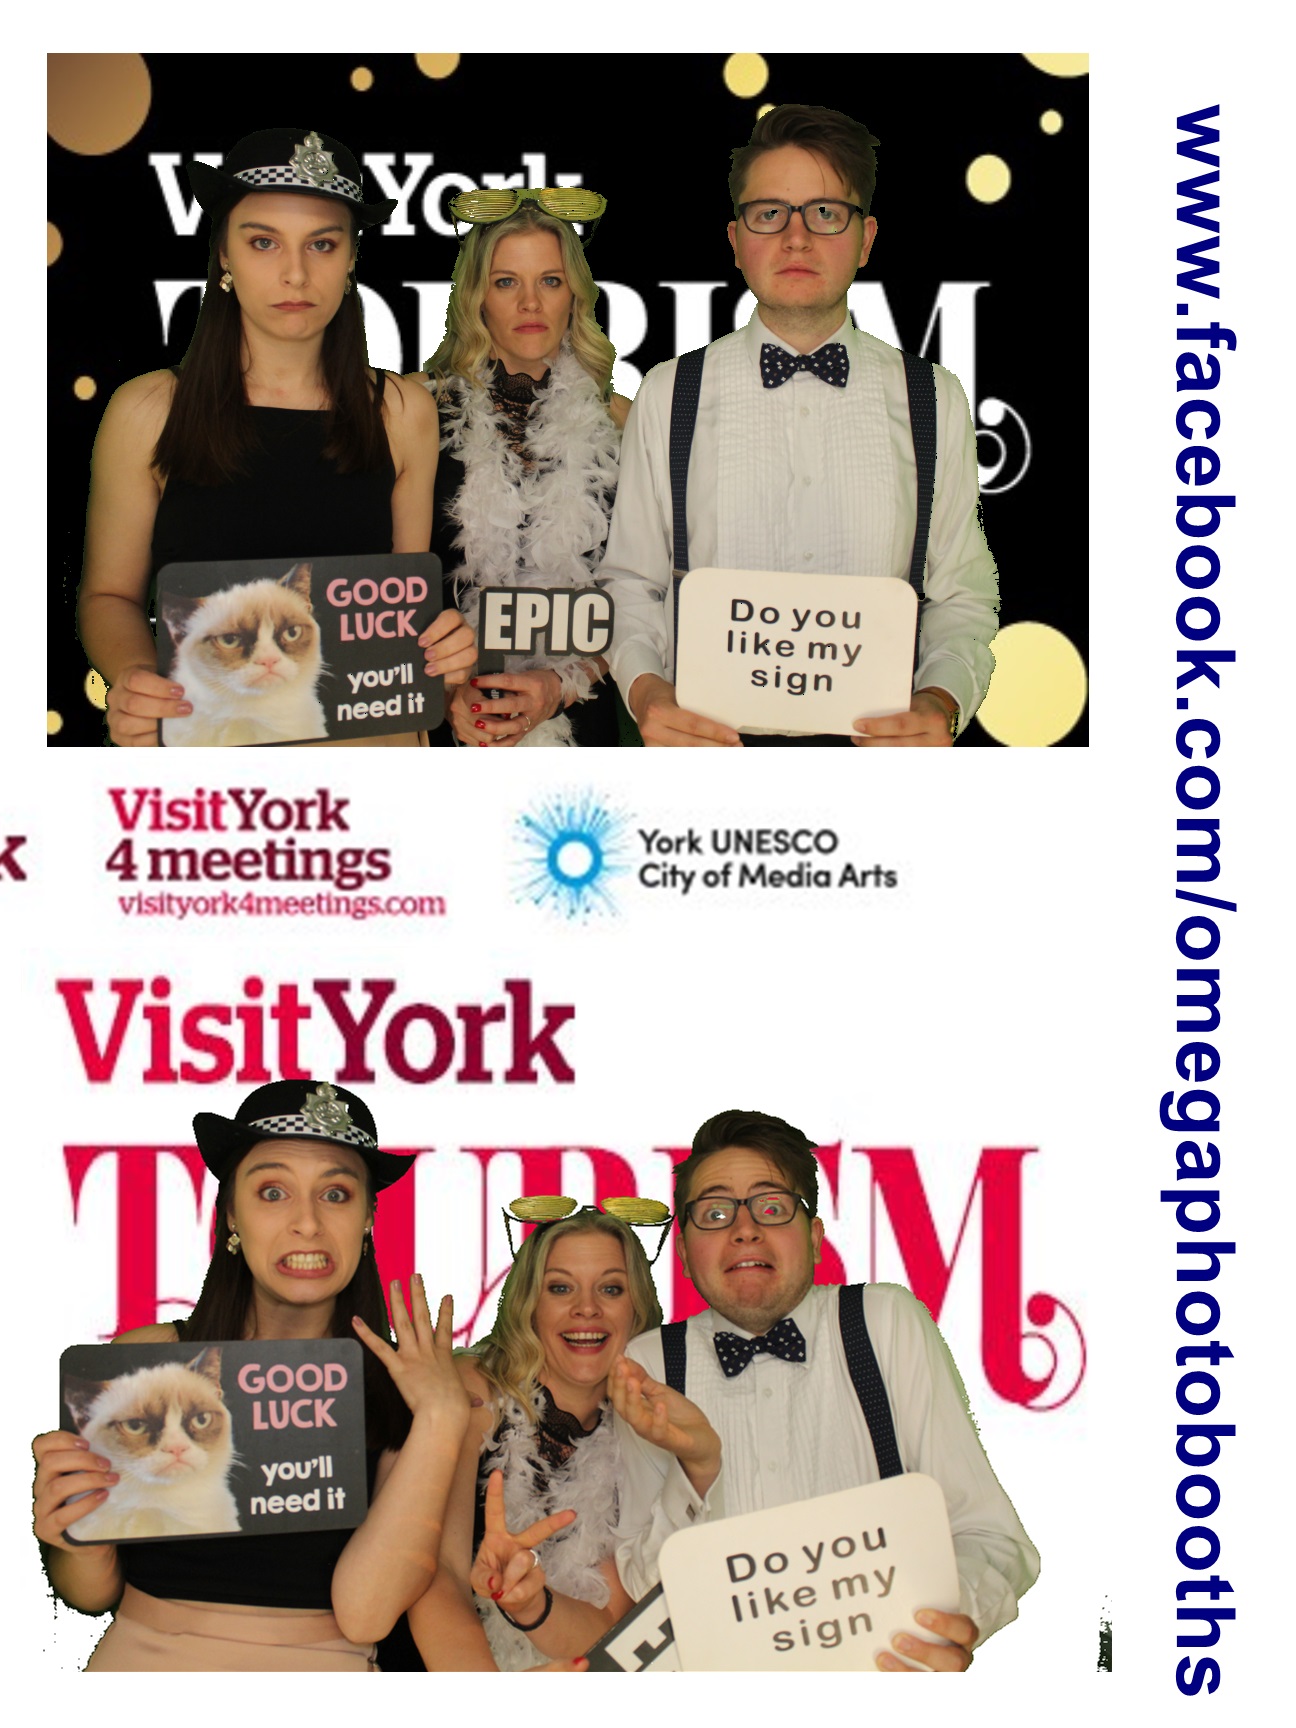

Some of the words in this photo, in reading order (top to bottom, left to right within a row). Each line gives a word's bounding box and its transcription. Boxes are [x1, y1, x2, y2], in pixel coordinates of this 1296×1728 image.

[326, 576, 429, 608] GOOD
[340, 609, 418, 642] LUCK
[484, 592, 610, 653] EPIC
[730, 598, 780, 625] Do
[791, 608, 861, 633] you
[727, 629, 795, 658] like
[808, 641, 862, 667] my
[347, 662, 415, 695] you'll
[750, 665, 832, 696] sign
[337, 694, 402, 722] need
[406, 692, 425, 714] it
[55, 975, 576, 1084] VisitYork
[237, 1362, 348, 1394] GOOD
[252, 1399, 336, 1432] LUCK
[260, 1455, 333, 1488] you'll
[250, 1488, 321, 1516] need
[326, 1486, 346, 1511] it
[725, 1551, 789, 1584] Do
[800, 1526, 887, 1575] you
[731, 1585, 817, 1623] like
[830, 1565, 896, 1600] my
[772, 1612, 873, 1653] sign
